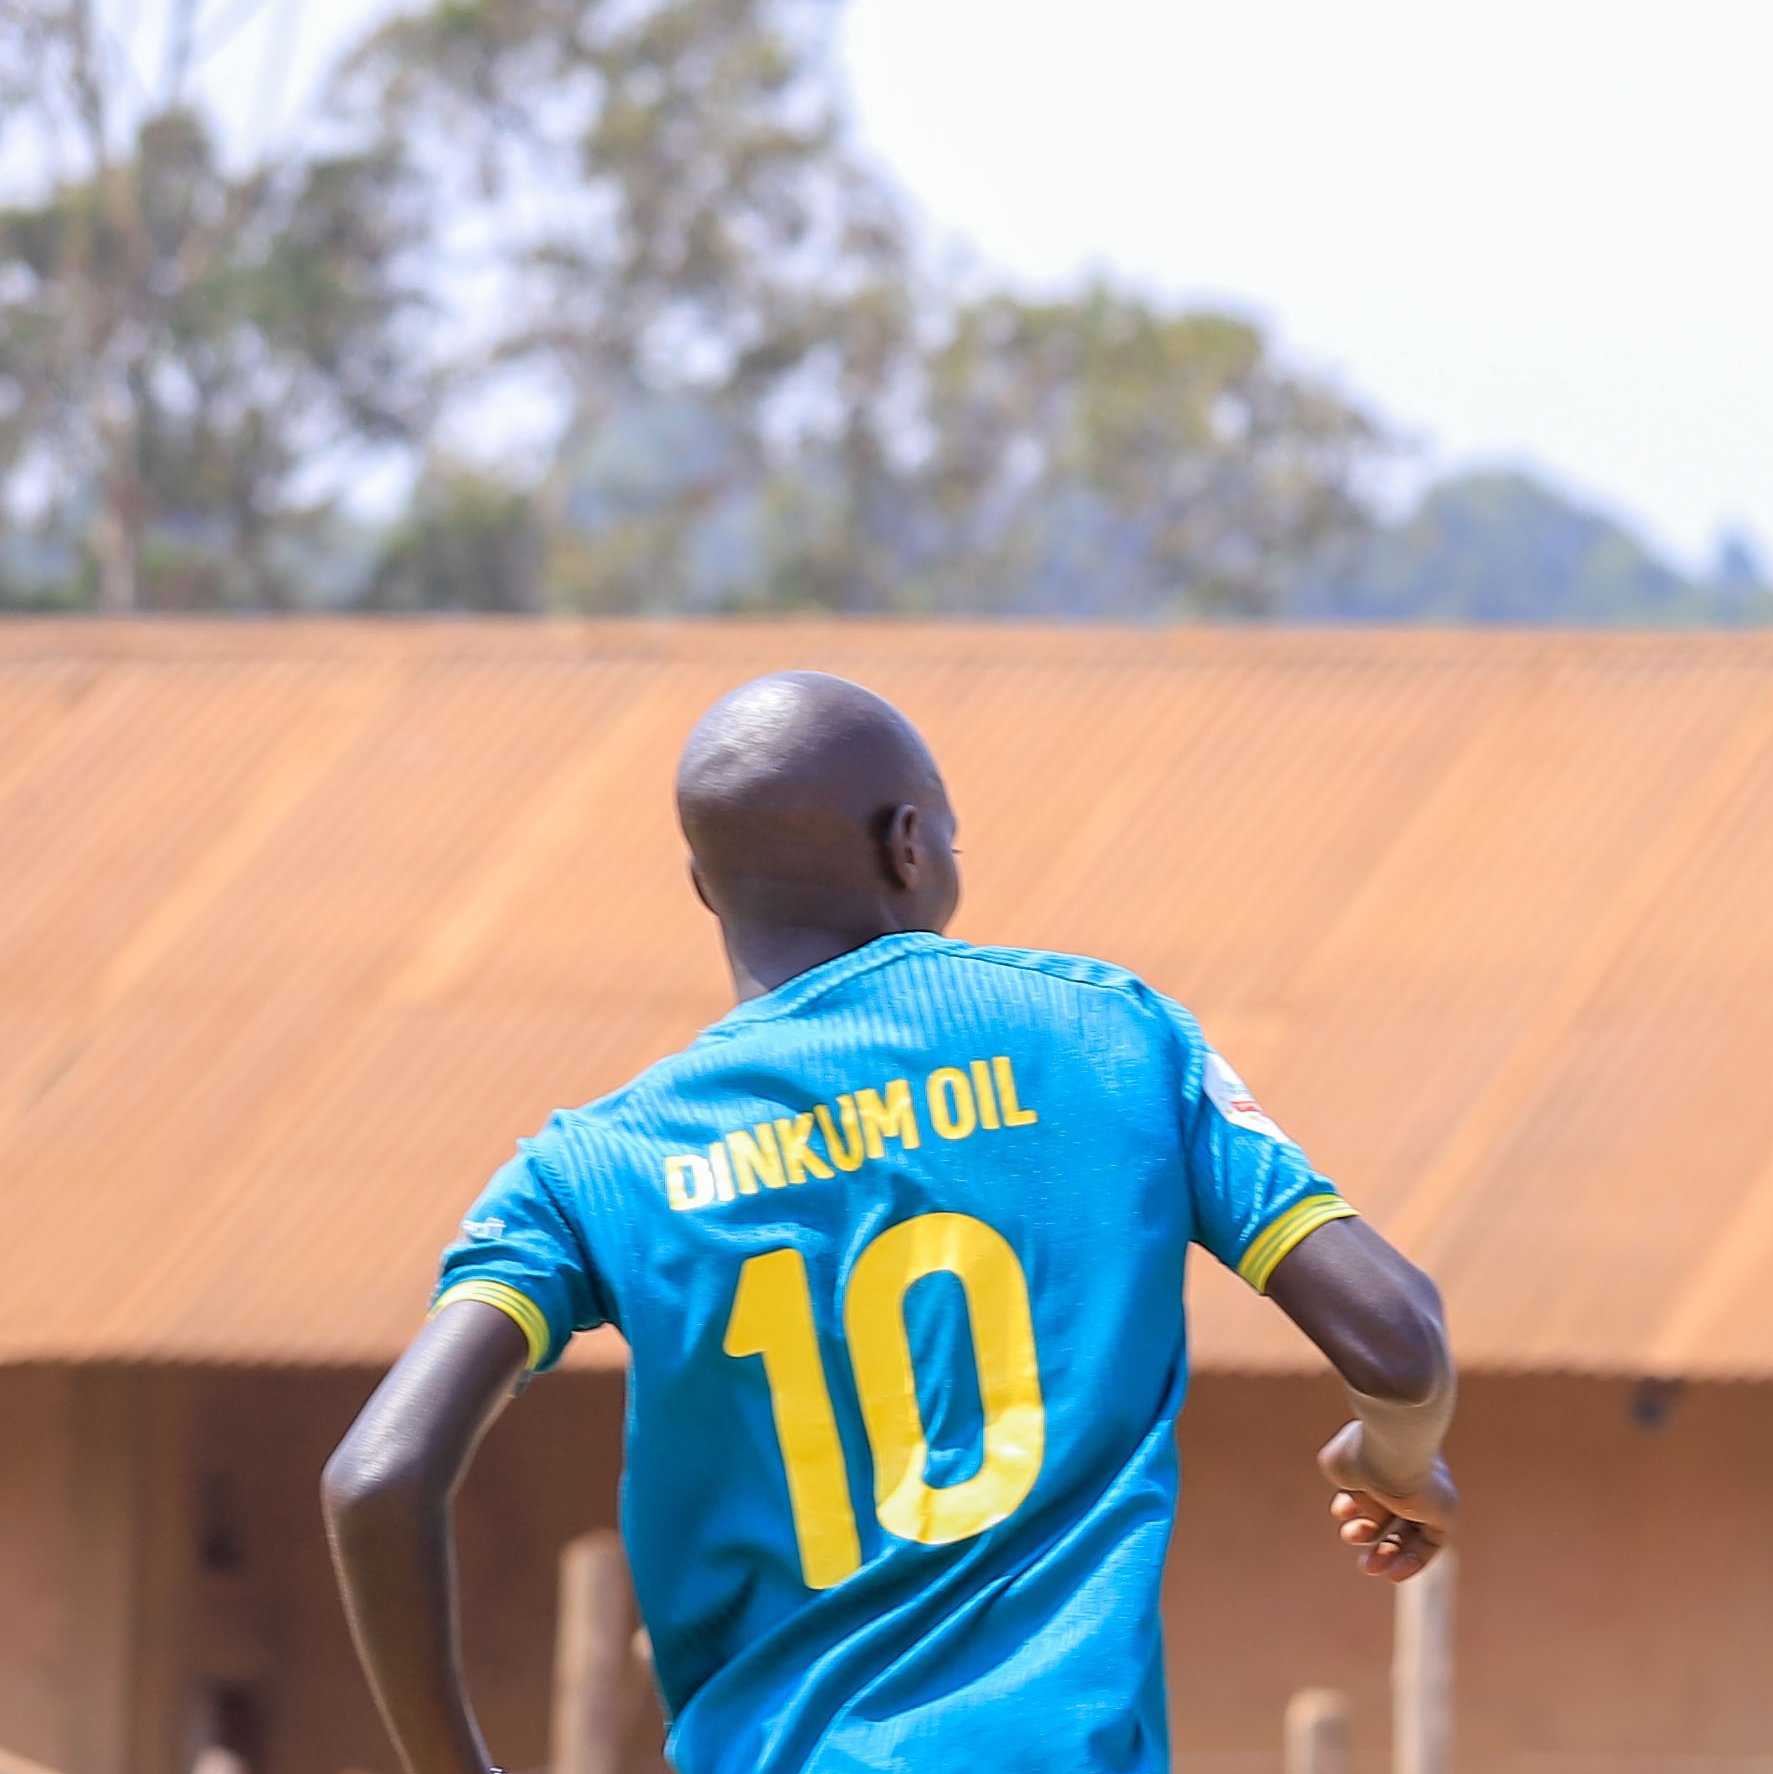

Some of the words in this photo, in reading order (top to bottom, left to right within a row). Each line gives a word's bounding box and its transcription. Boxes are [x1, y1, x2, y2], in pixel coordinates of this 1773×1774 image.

[664, 1078, 921, 1211] DINKUM
[926, 1056, 1039, 1140] OIL
[722, 1211, 1046, 1590] 10
